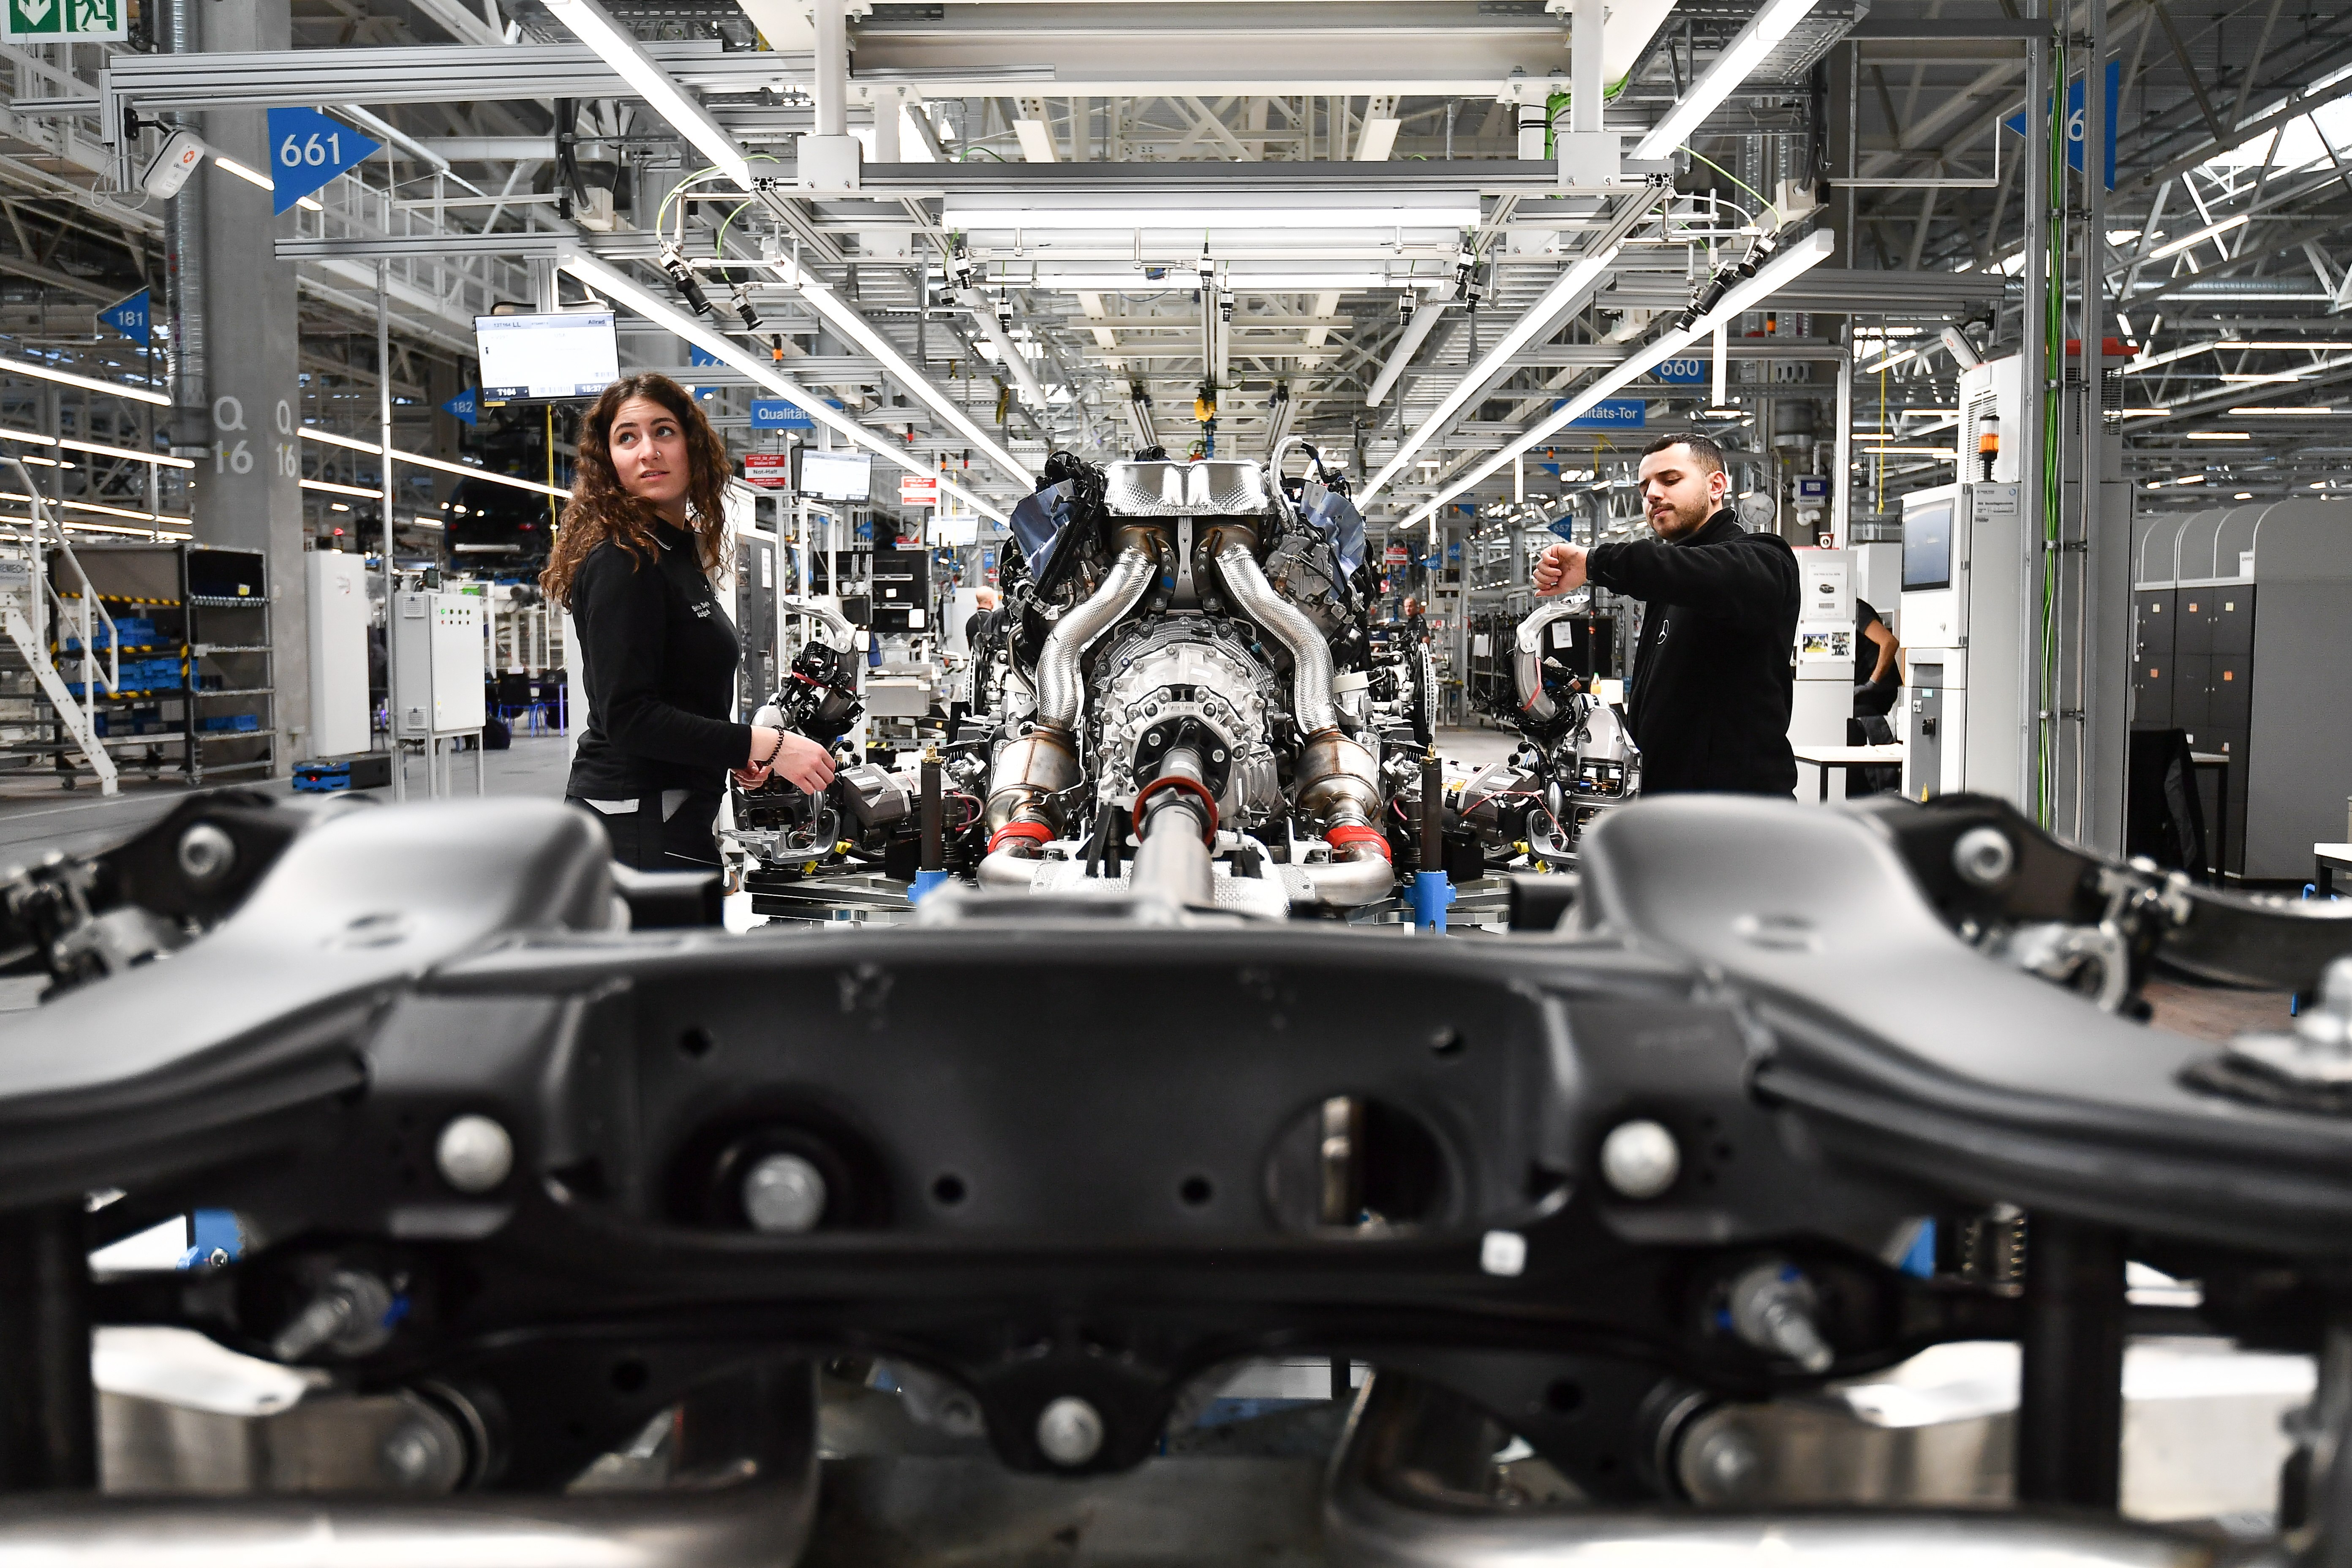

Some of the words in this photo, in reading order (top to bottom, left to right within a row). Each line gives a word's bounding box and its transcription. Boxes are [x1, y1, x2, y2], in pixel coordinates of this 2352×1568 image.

[280, 133, 340, 167] 661
[118, 311, 143, 327] 181
[1661, 360, 1699, 376] 660
[213, 396, 248, 432] Q
[276, 400, 293, 436] Q
[453, 401, 473, 412] 182
[759, 408, 810, 420] Qualität
[212, 440, 253, 474] 16
[276, 443, 296, 478] 16
